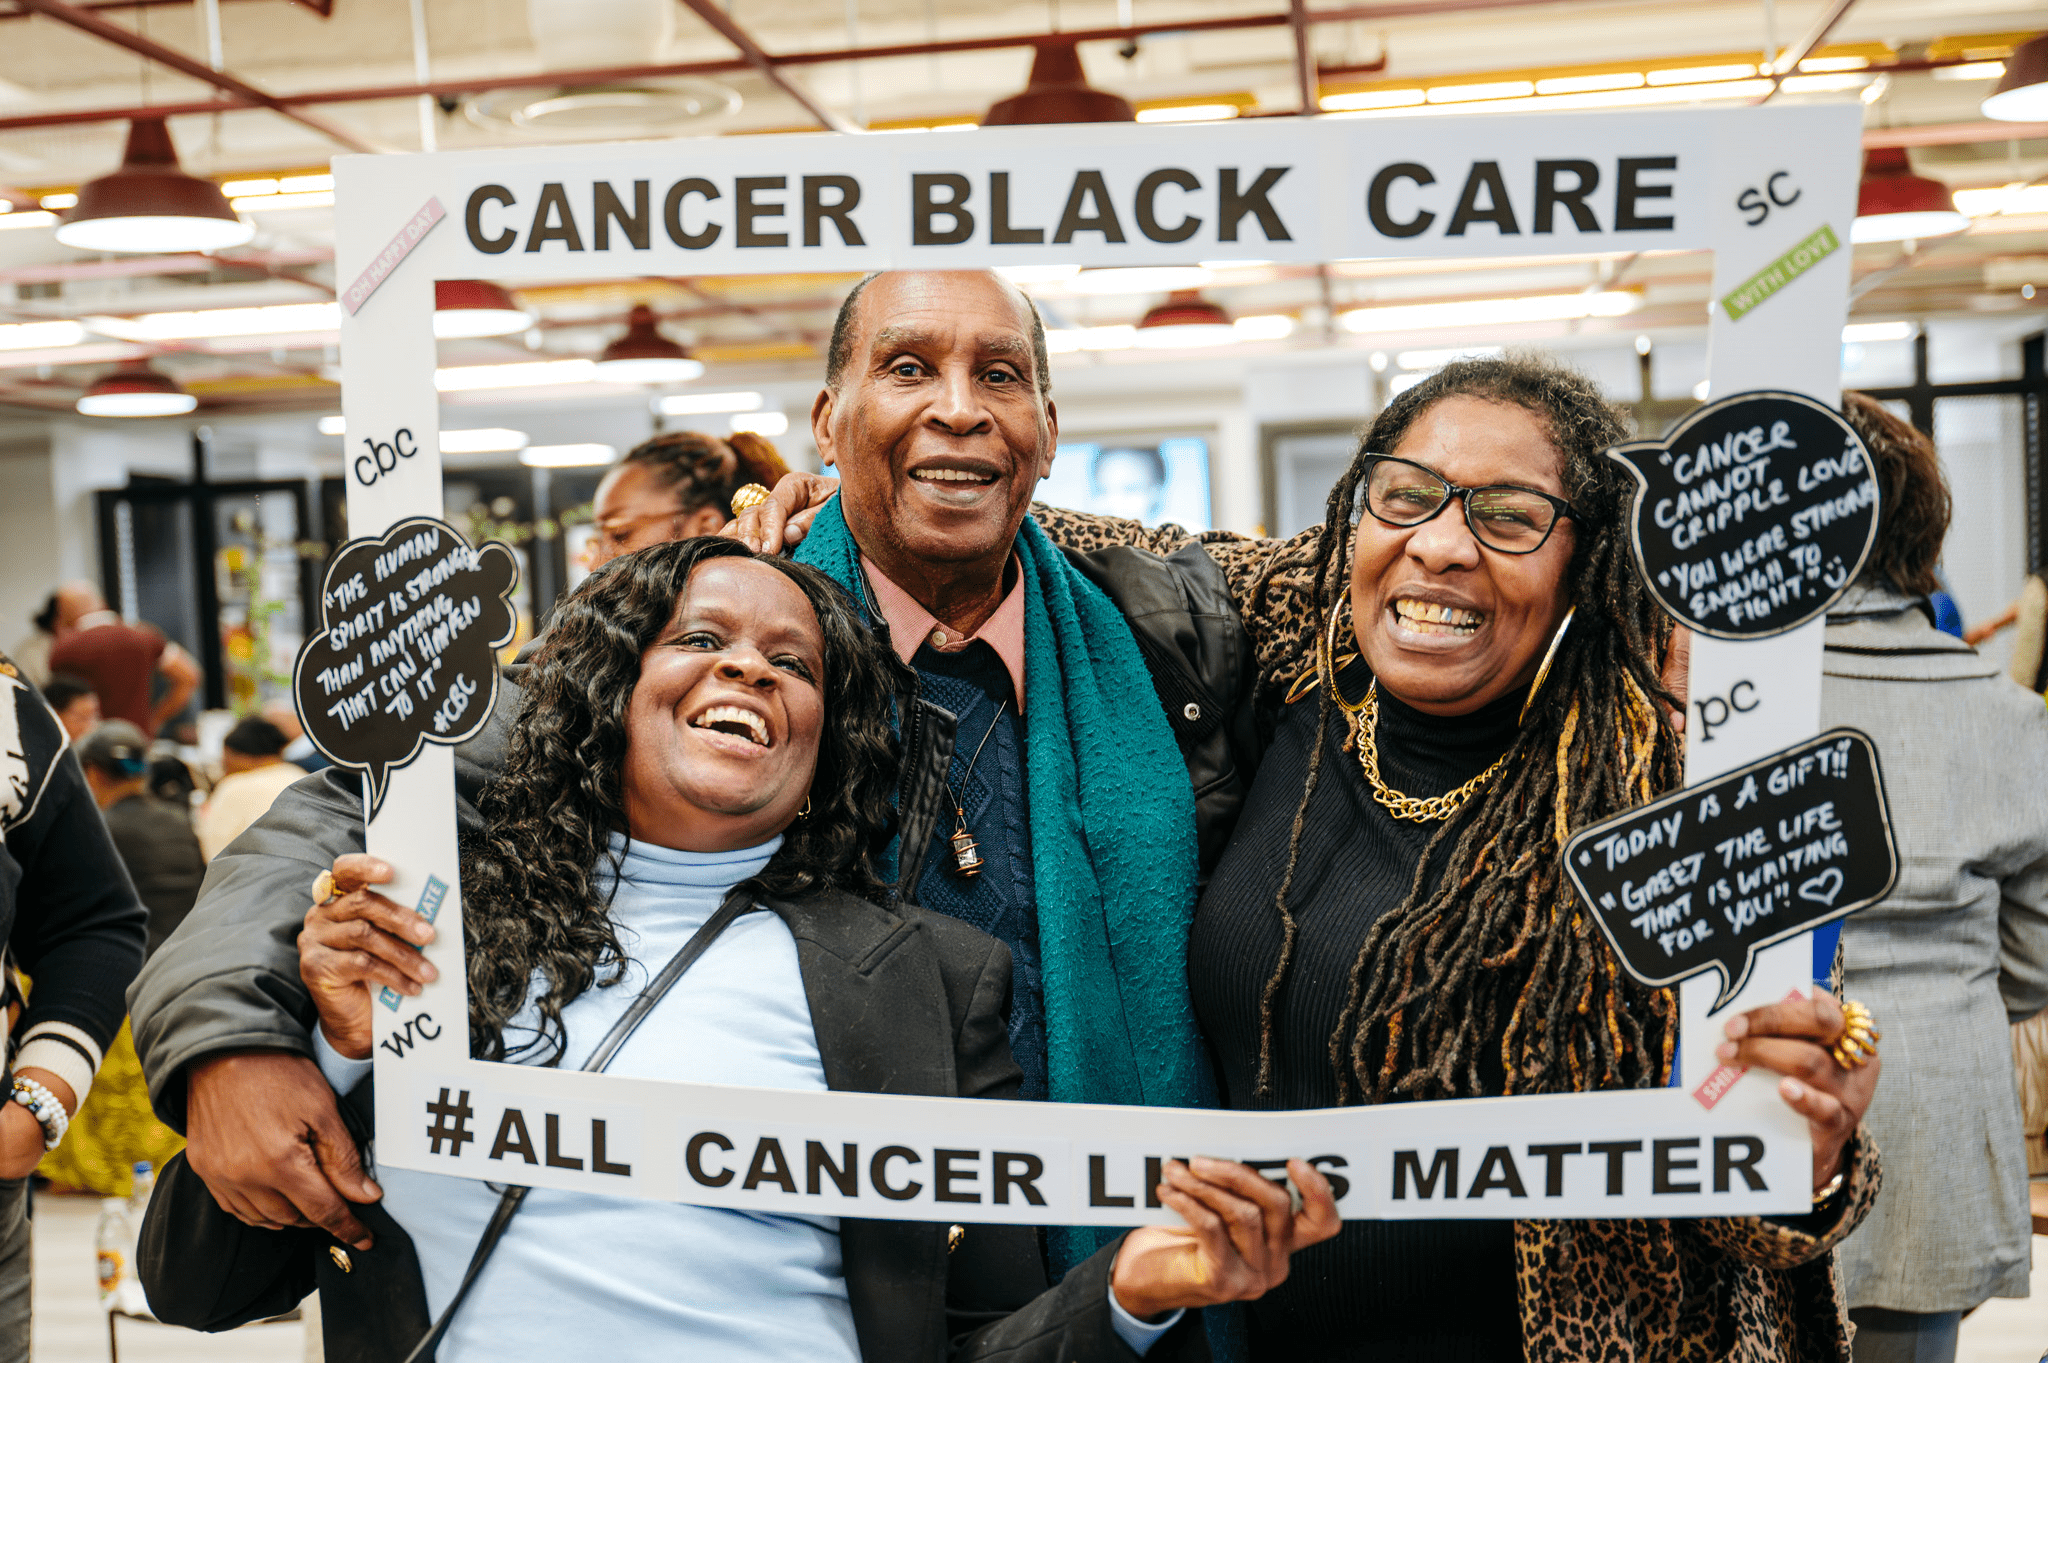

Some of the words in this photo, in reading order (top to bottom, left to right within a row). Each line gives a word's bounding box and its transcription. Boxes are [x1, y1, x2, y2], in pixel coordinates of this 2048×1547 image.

[465, 175, 867, 255] CANCER
[911, 167, 1293, 246] BLACK
[1366, 156, 1678, 239] CARE
[1733, 265, 1785, 309] WITH
[1782, 233, 1832, 276] LOVE
[354, 427, 418, 487] cbc
[1654, 456, 1771, 529] CANNOT
[1671, 478, 1790, 550] CRIPPLE
[374, 526, 440, 583] HUMAN
[1689, 558, 1784, 620] ENOUGH
[1788, 542, 1822, 572] TO
[1720, 524, 1788, 577] WERE
[316, 653, 364, 697] THAN
[369, 593, 453, 668] ANYTHING
[330, 600, 386, 652] SPIRIT
[389, 591, 408, 617] IS
[327, 681, 378, 732] THAT
[380, 651, 418, 697] CAN
[417, 596, 482, 662] HAPPEN
[385, 688, 414, 722] TO
[433, 673, 477, 734] #CBC
[1693, 680, 1760, 742] pc
[1698, 793, 1721, 824] IS
[1734, 774, 1758, 810] A
[1715, 826, 1772, 869] THE
[1778, 801, 1843, 844] LIFE
[1630, 892, 1692, 940] THAT
[1708, 878, 1732, 906] IS
[1737, 831, 1848, 896] WAITING
[1658, 918, 1714, 957] FOR
[685, 1131, 1049, 1207] CANCER
[1392, 1135, 1769, 1200] MATTER
